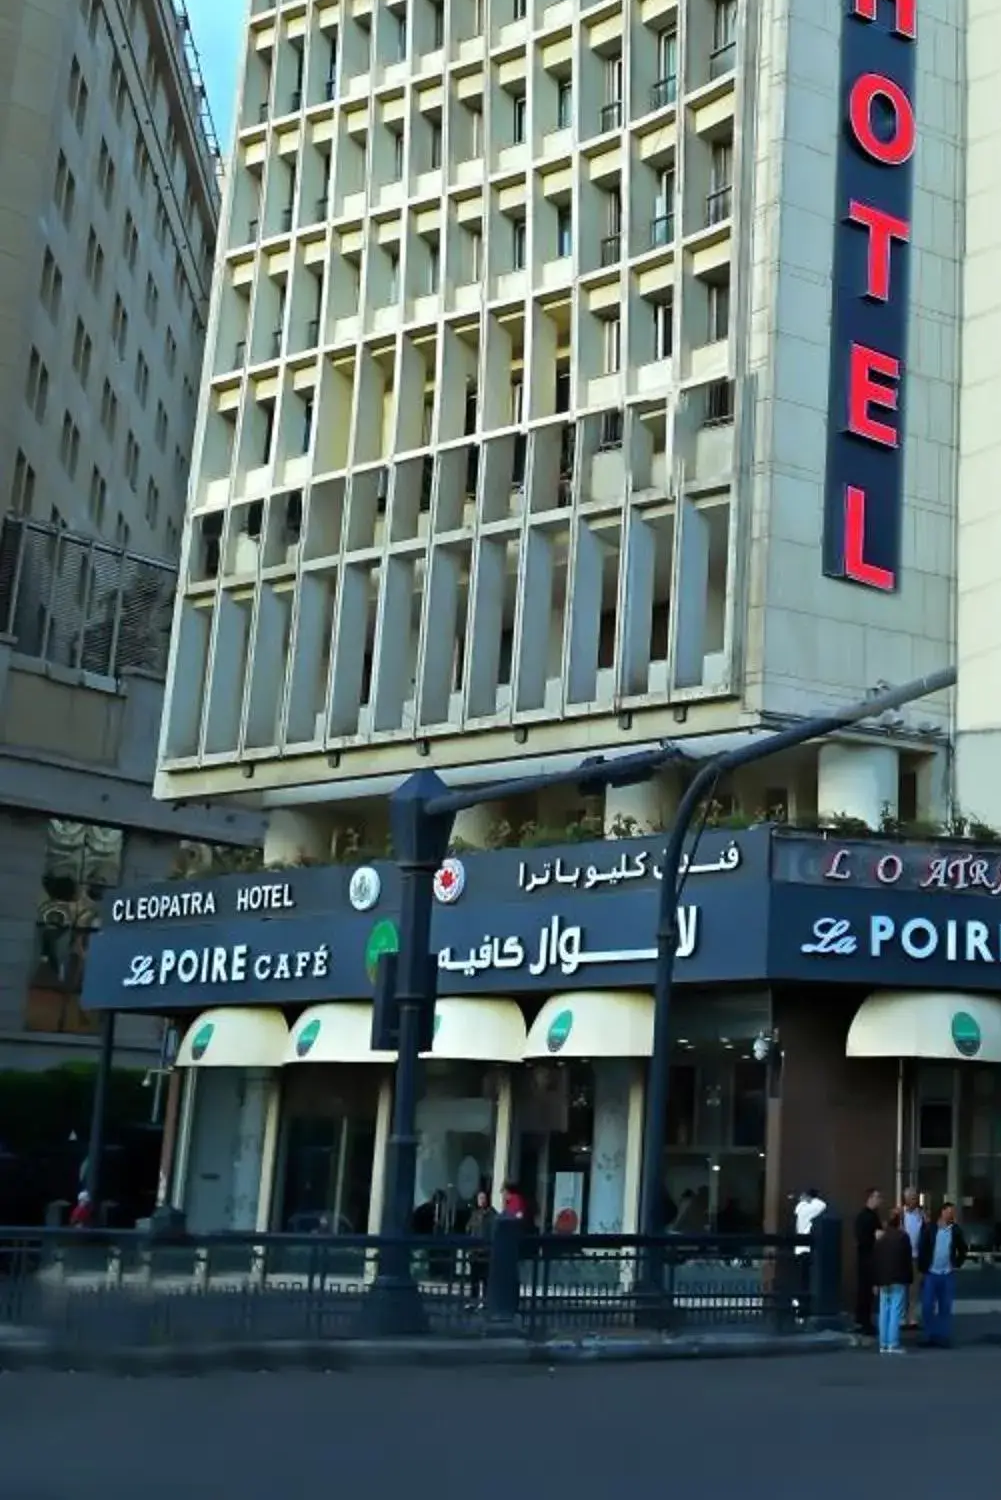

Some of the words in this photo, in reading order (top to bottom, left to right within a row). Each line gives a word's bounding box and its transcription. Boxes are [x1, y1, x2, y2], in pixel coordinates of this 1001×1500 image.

[112, 891, 216, 922] CLEOPATRA
[236, 883, 294, 912] HOTEL
[159, 944, 248, 985] POIRE
[253, 943, 330, 981] CAFÉ
[436, 933, 525, 977] كافيه
